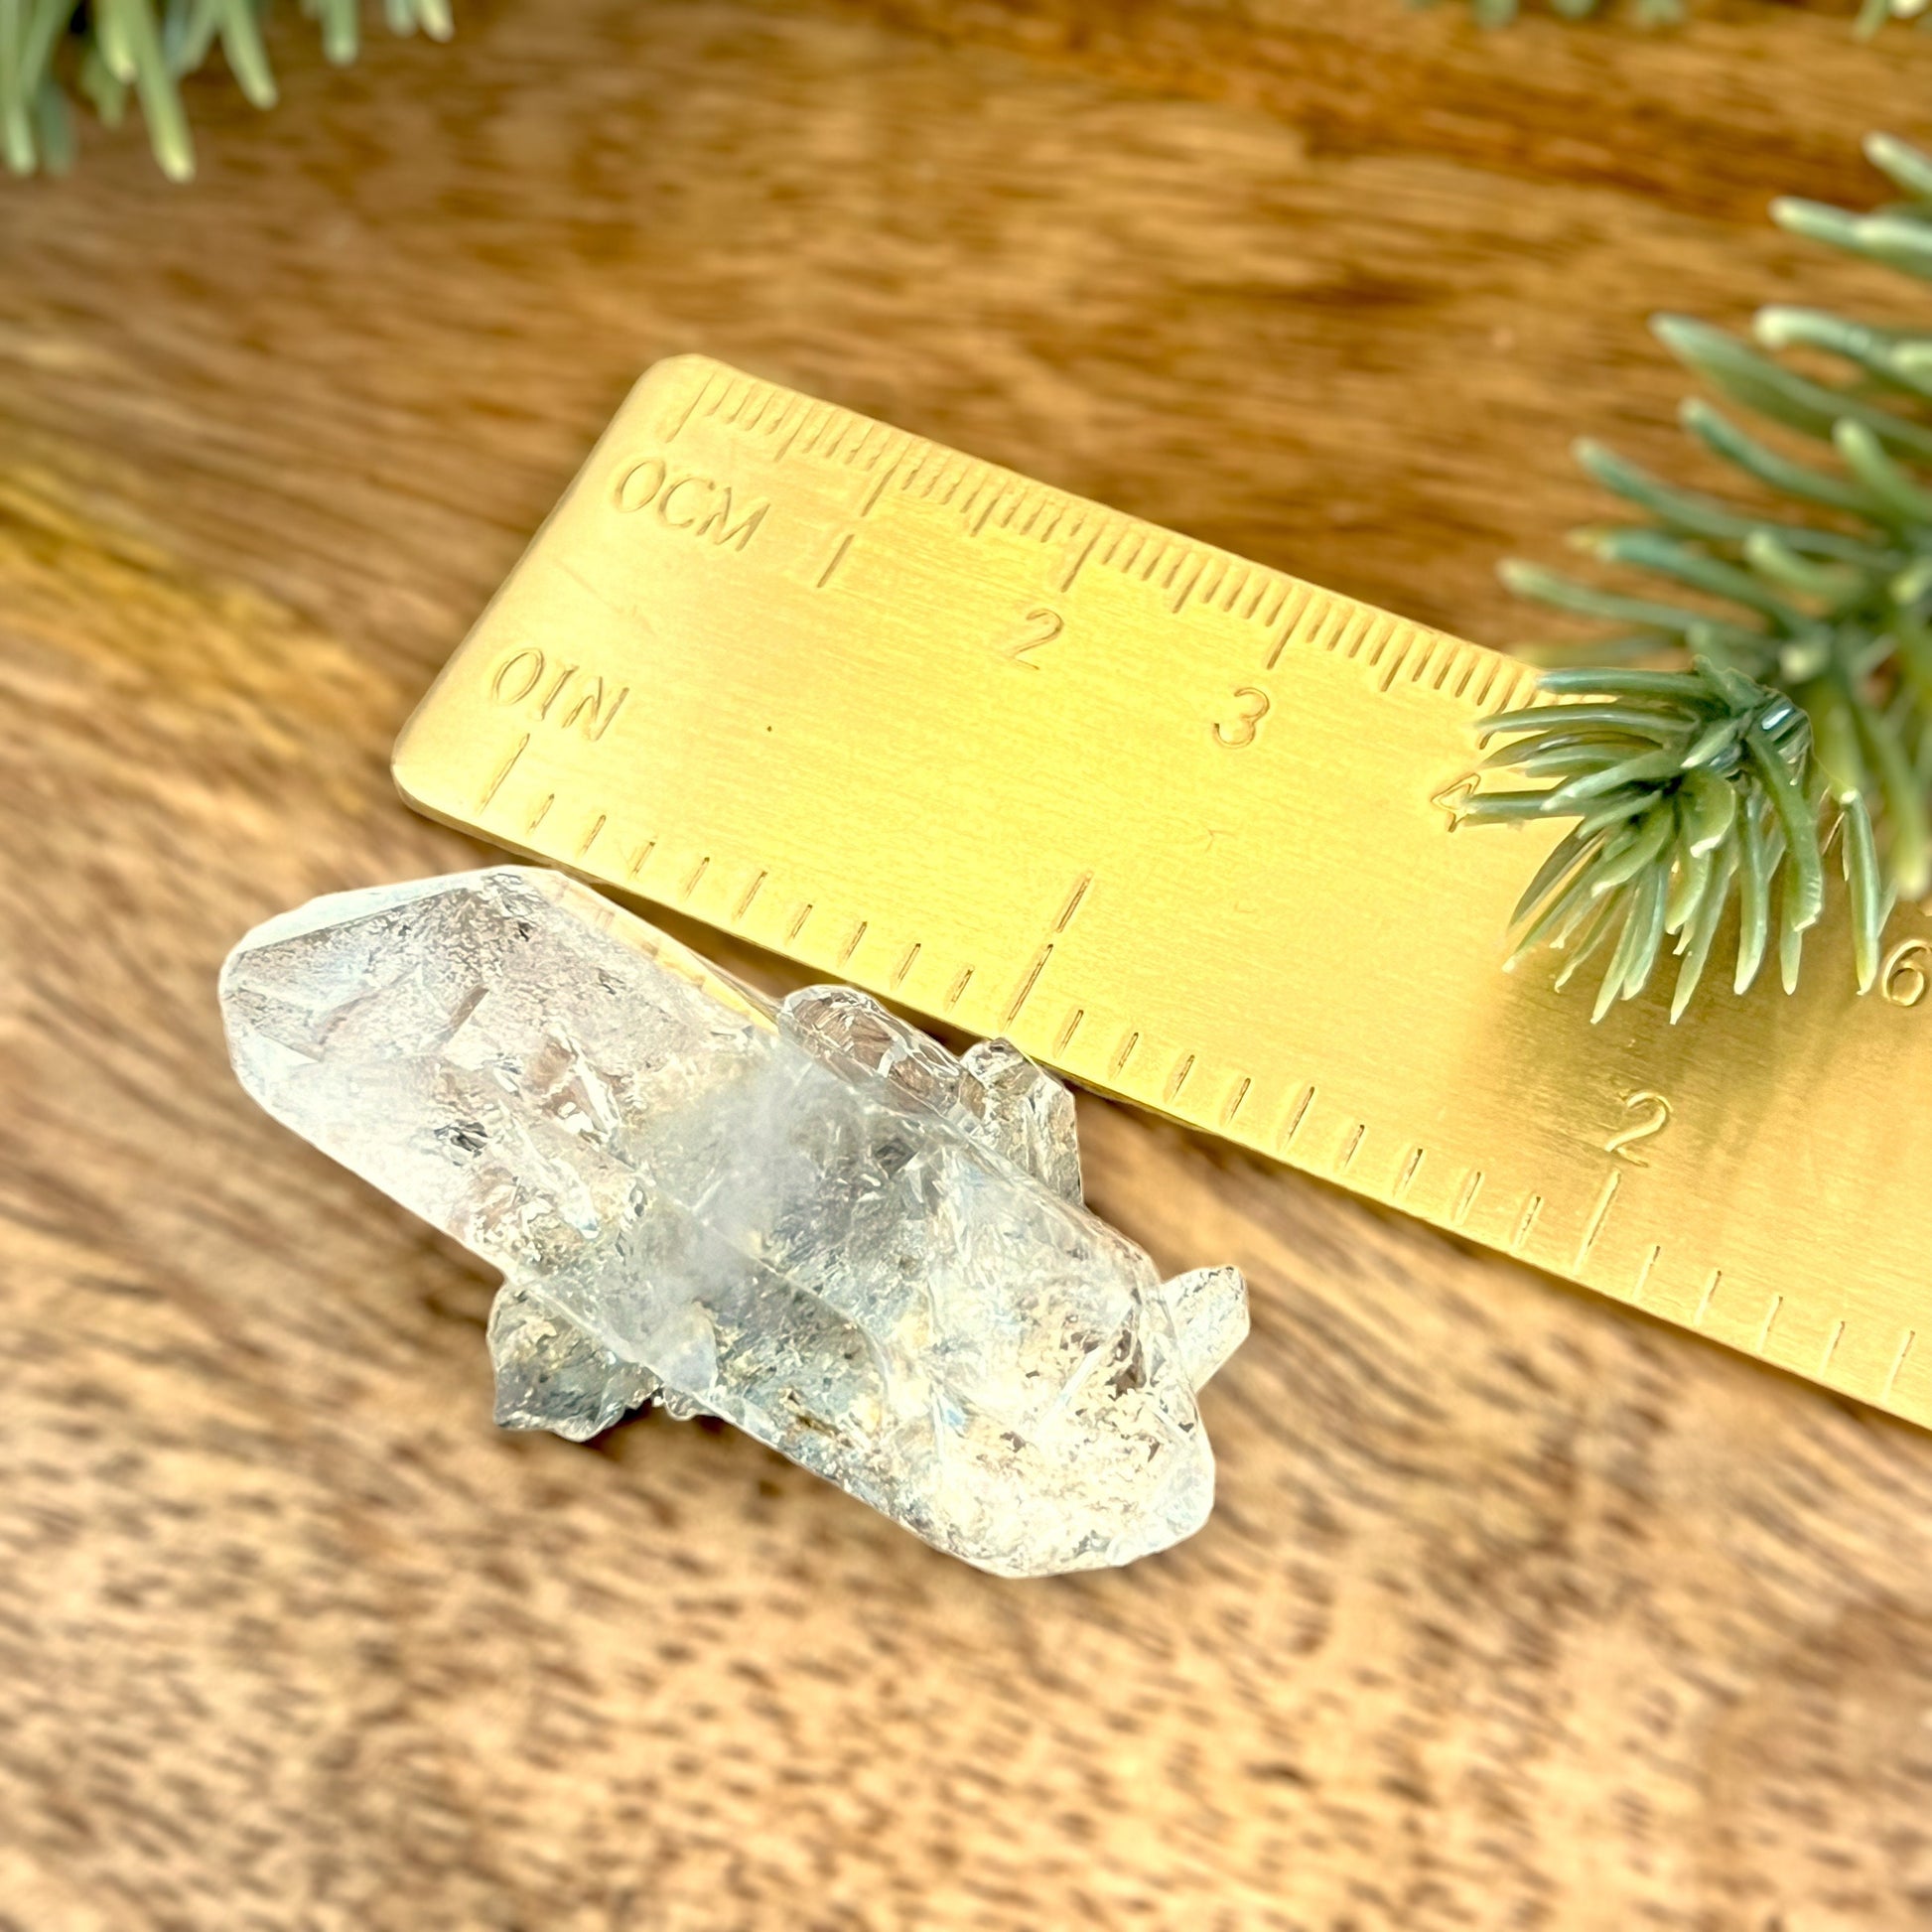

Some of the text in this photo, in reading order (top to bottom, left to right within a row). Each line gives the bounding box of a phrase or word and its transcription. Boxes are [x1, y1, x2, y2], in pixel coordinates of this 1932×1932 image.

[816, 533, 856, 589] 1
[1010, 608, 1065, 671] 2
[1211, 686, 1270, 749] 3
[1881, 939, 1932, 1007] 6
[1606, 1090, 1673, 1167] 2
